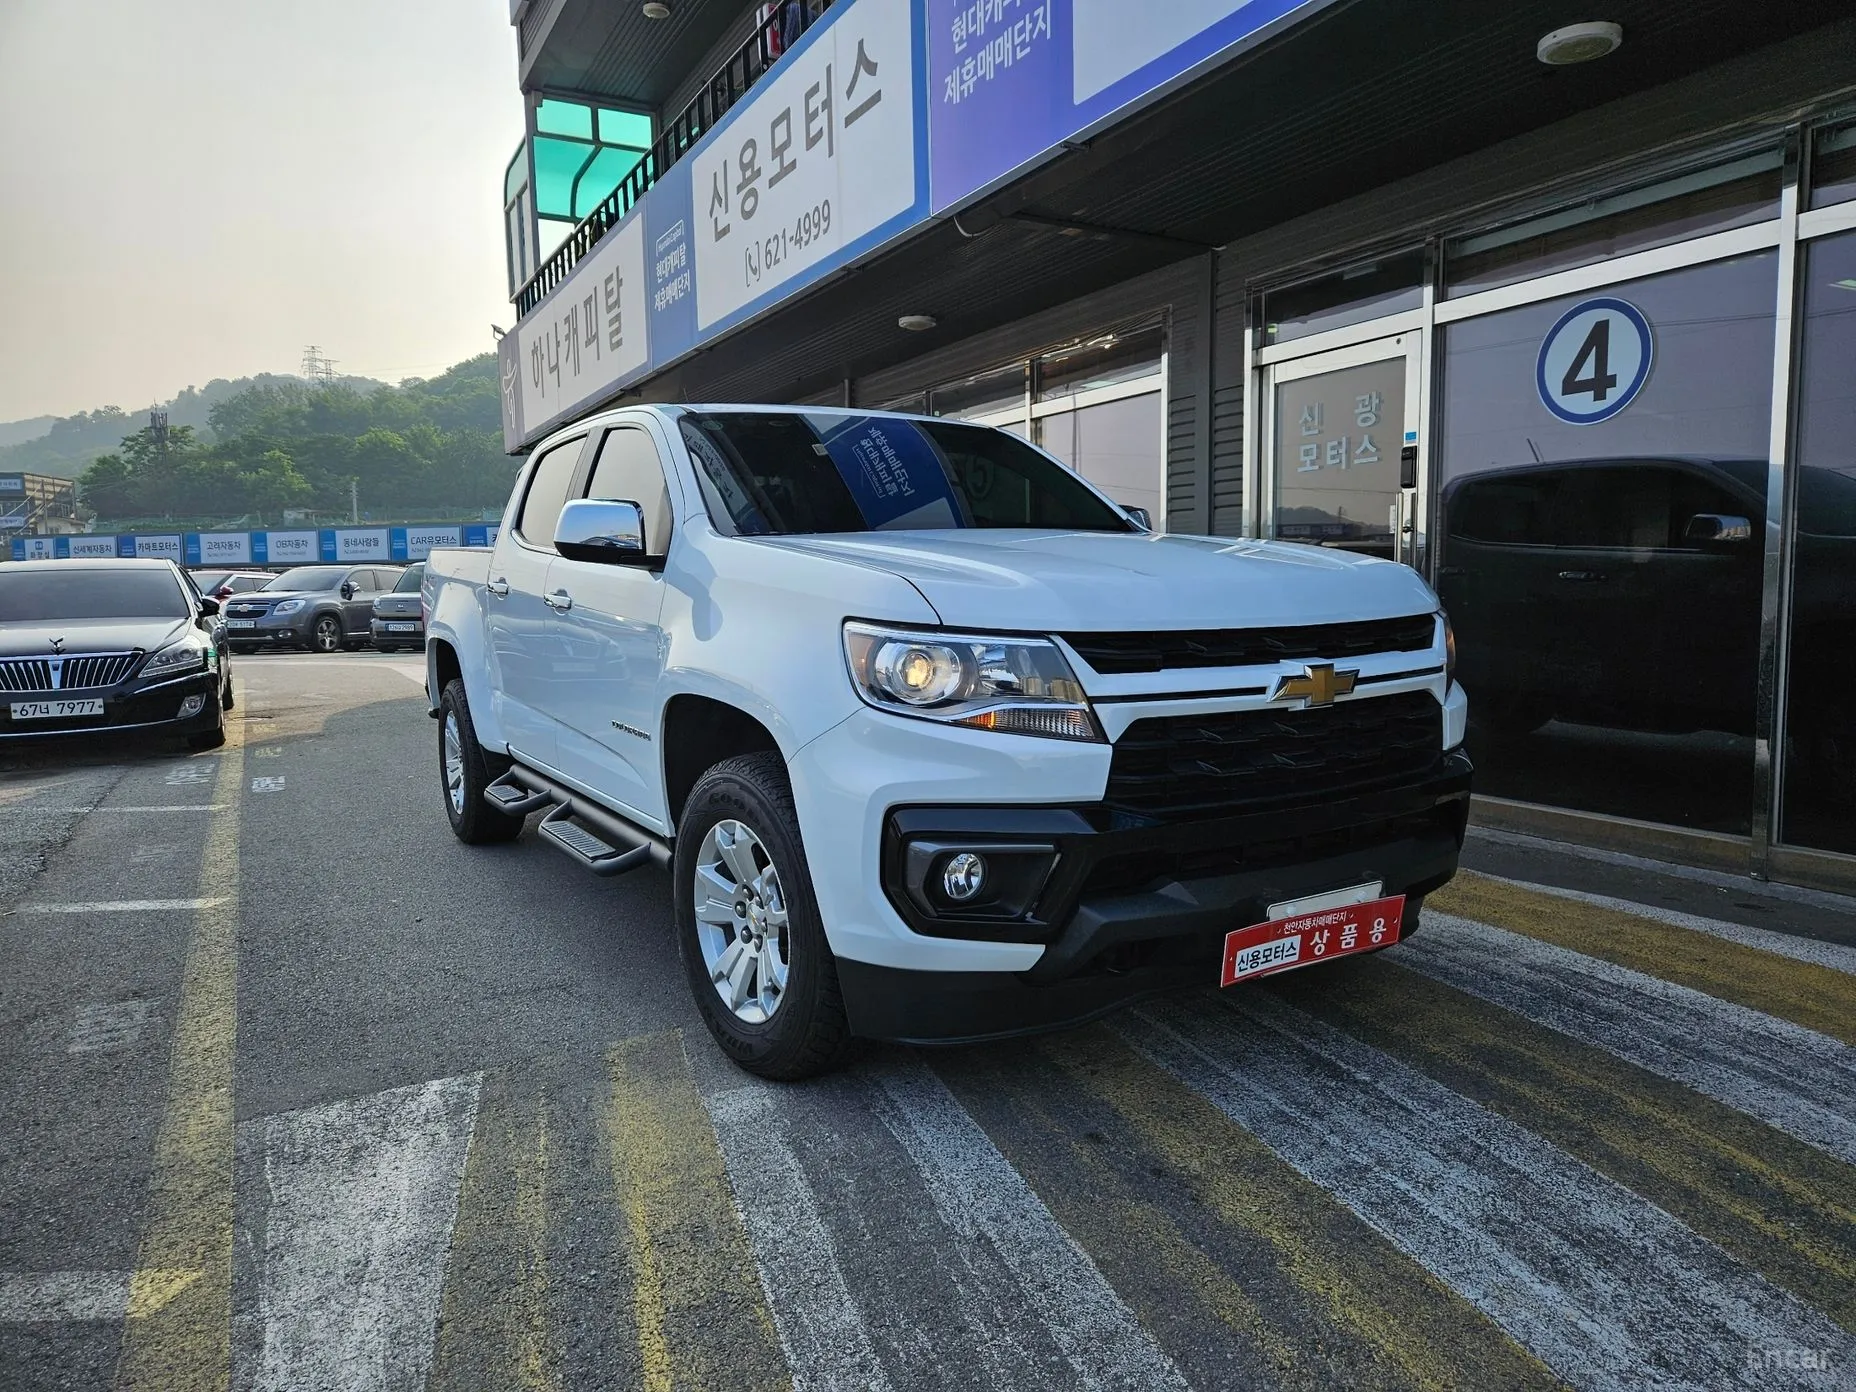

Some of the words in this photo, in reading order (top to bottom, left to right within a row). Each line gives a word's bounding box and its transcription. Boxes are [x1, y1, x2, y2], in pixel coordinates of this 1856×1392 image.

[944, 0, 1051, 105] 제휴매매단지
[952, 0, 1021, 54] 현대캐
[709, 38, 882, 242] 신용모터스
[765, 199, 831, 270] 621-4999
[656, 241, 686, 284] 현대캐피탈
[531, 265, 623, 398] 하나캐피탈
[1561, 318, 1617, 402] 4
[1296, 434, 1380, 472] 모터스
[20, 704, 50, 717] 67너
[56, 701, 96, 714] 7977
[1283, 911, 1348, 935] 천안자동차매매단지
[1237, 941, 1298, 972] 신용모터스
